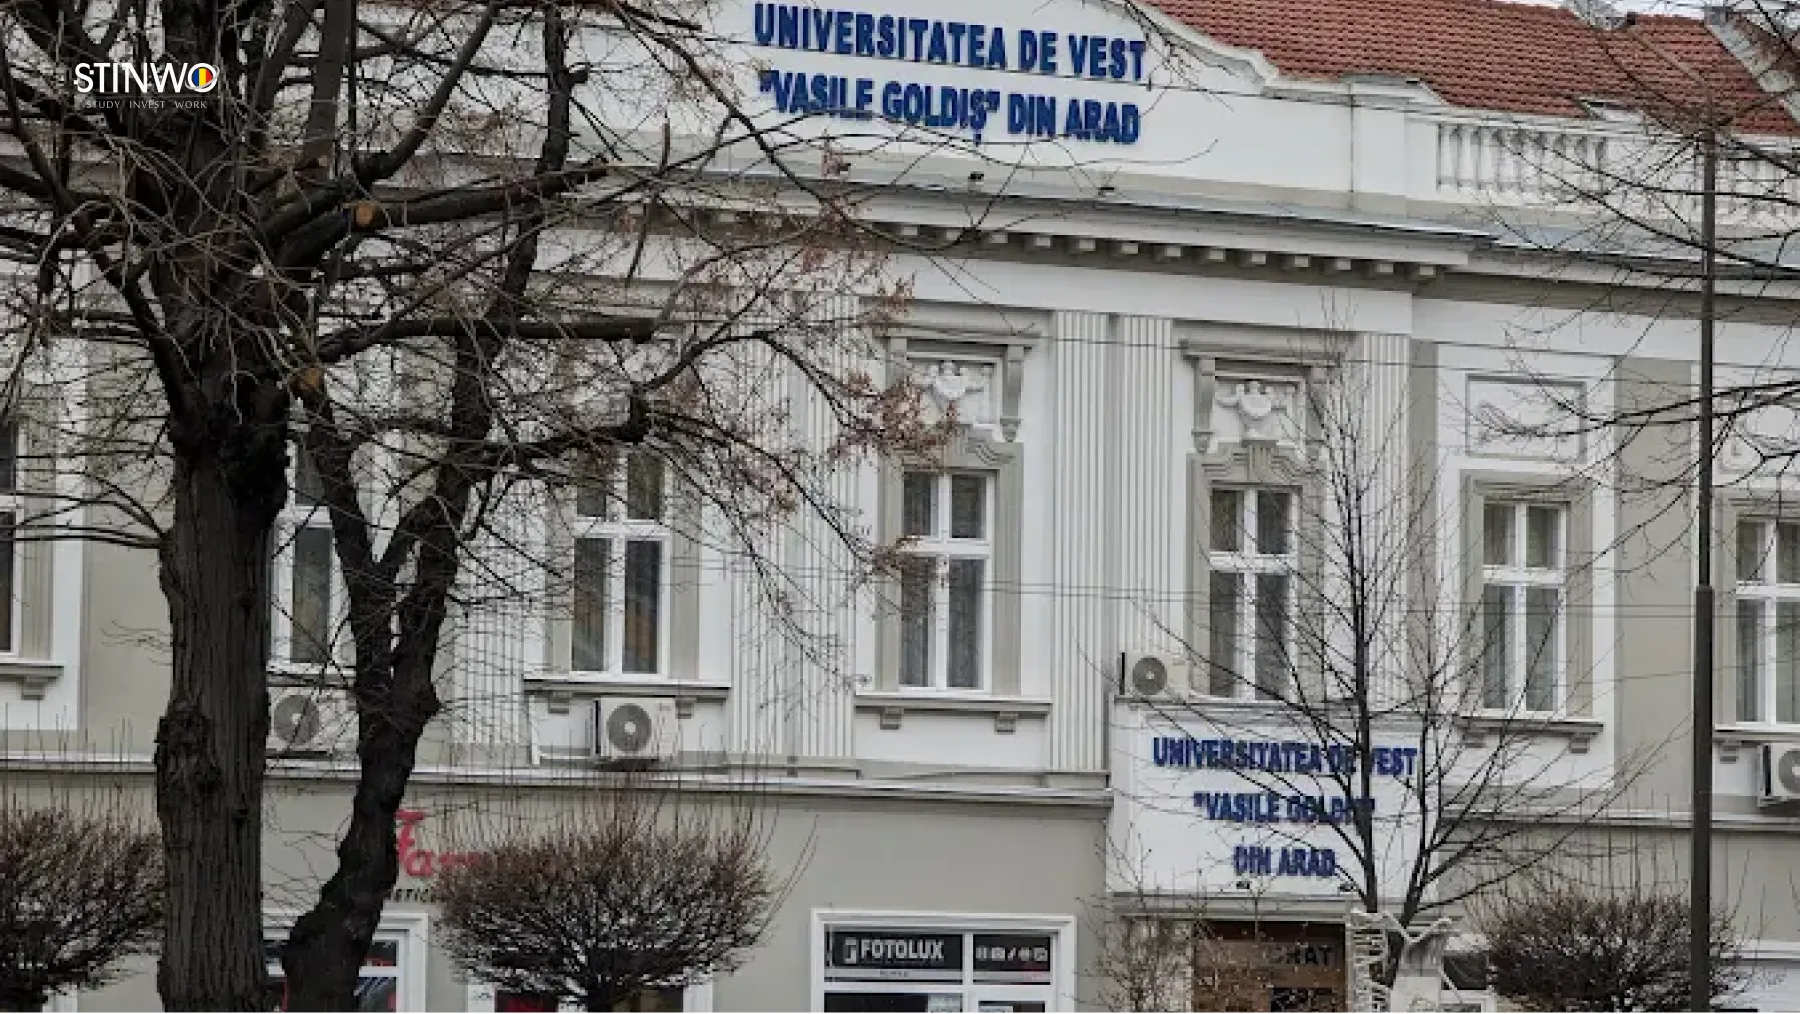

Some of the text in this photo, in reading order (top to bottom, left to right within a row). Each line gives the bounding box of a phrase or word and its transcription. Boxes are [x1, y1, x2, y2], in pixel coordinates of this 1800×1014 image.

[754, 3, 1146, 81] UNIVERSITATEA DE VEST
[1007, 93, 1056, 136] DIN
[1065, 98, 1141, 144] ARAD
[1233, 844, 1271, 875] DIN
[860, 938, 945, 960] FOTOLUX
